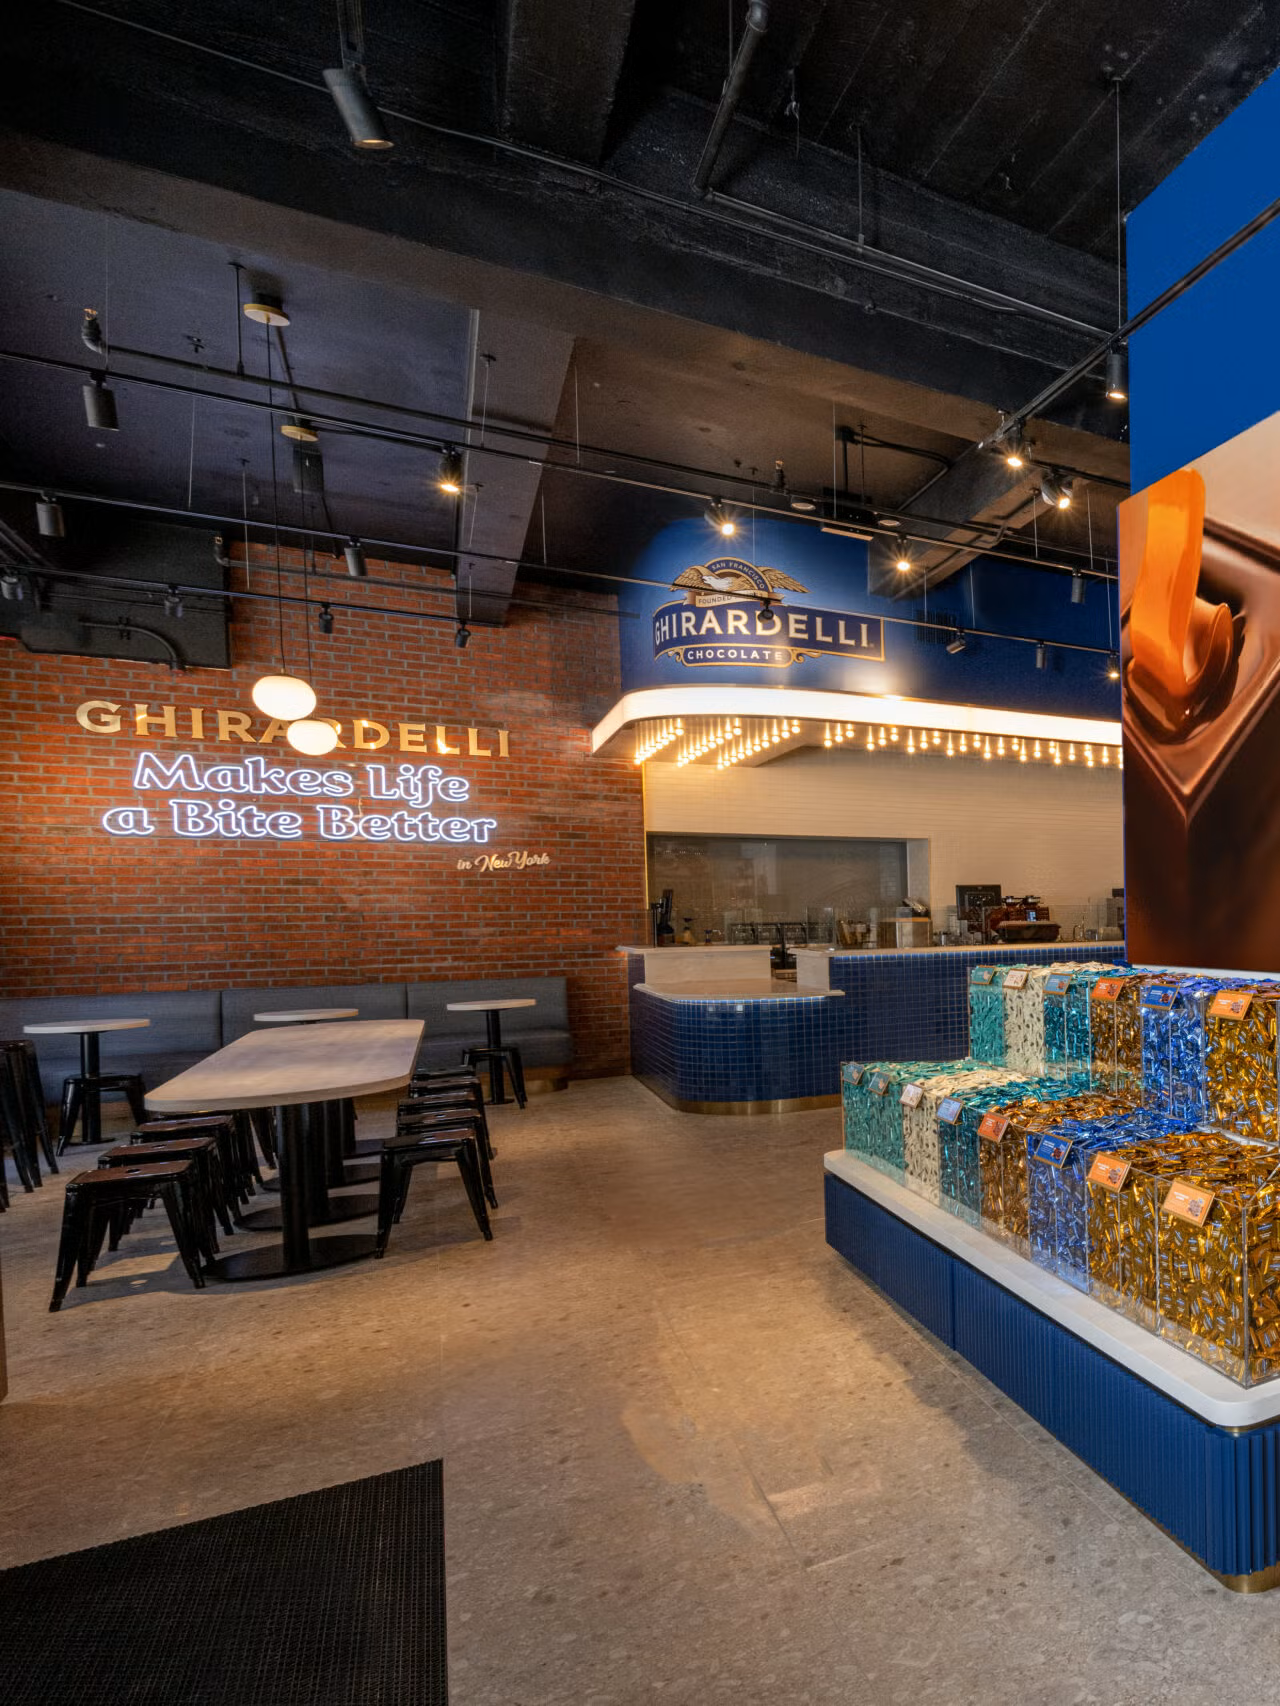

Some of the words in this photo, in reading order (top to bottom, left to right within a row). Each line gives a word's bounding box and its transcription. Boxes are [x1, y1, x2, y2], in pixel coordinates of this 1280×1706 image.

[711, 562, 726, 570] SAN
[729, 562, 765, 589] FRANCISCO
[655, 609, 869, 647] GHIRARDELLI
[687, 650, 783, 662] CHOCOLATE
[132, 751, 354, 797] Makes
[366, 763, 470, 808] Life
[102, 803, 154, 837] a
[169, 799, 303, 840] Bite
[316, 804, 498, 844] Better
[456, 859, 473, 870] in
[474, 854, 512, 873] New
[508, 850, 551, 870] York
